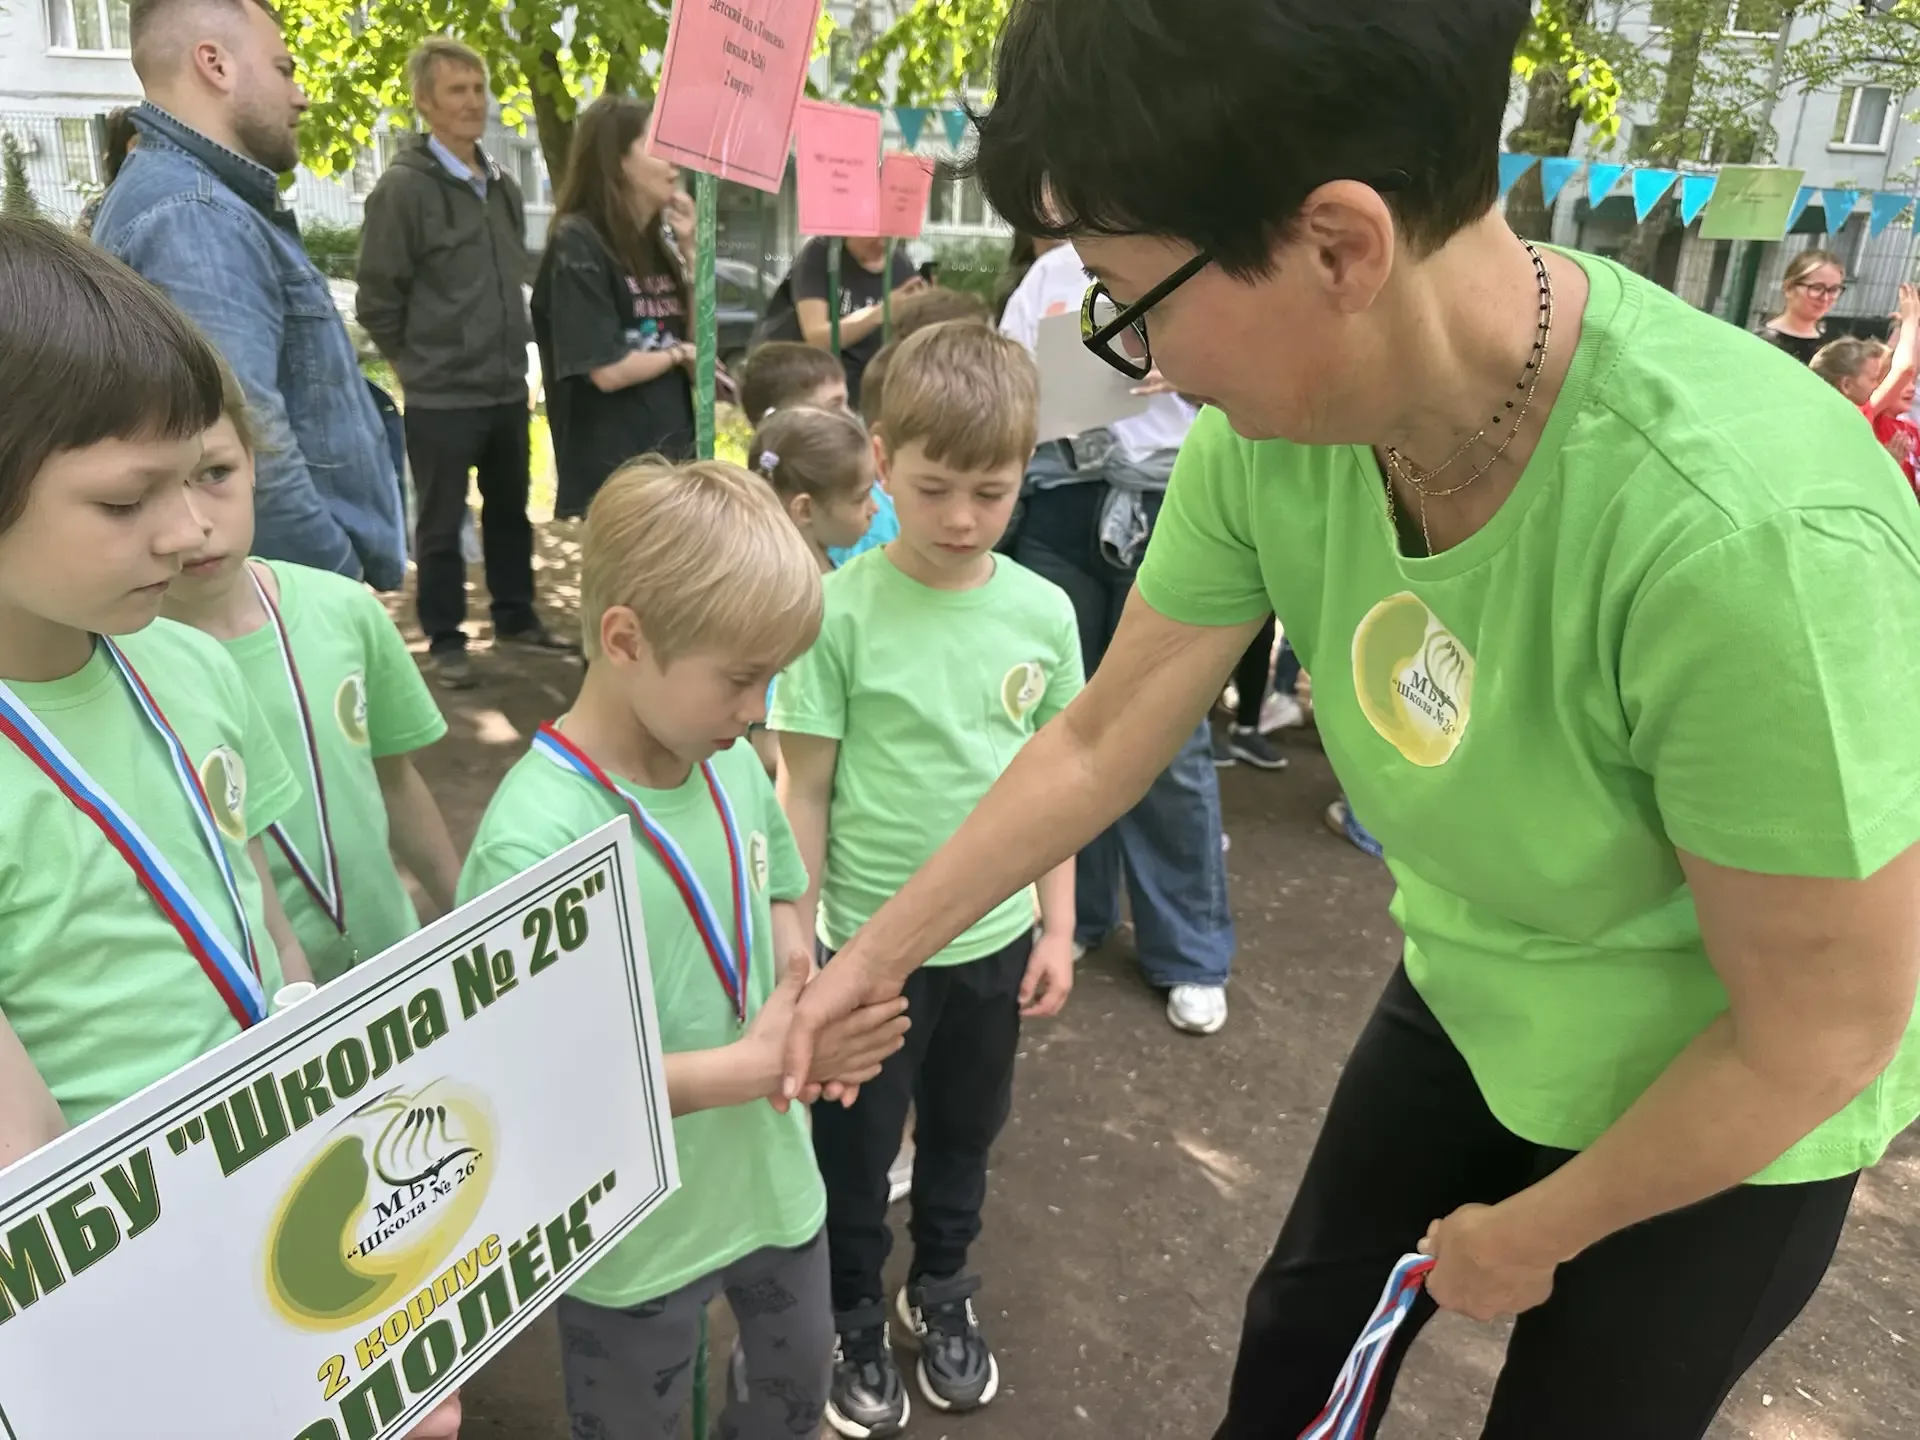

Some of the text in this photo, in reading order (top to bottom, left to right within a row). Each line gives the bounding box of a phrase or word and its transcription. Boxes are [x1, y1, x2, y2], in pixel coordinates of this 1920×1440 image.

[0, 868, 607, 1326] МБУ "Школа № 26"
[431, 1179, 453, 1204] №
[293, 1169, 618, 1440] ПОЛЁК"
[317, 1232, 502, 1402] 2 корпус
